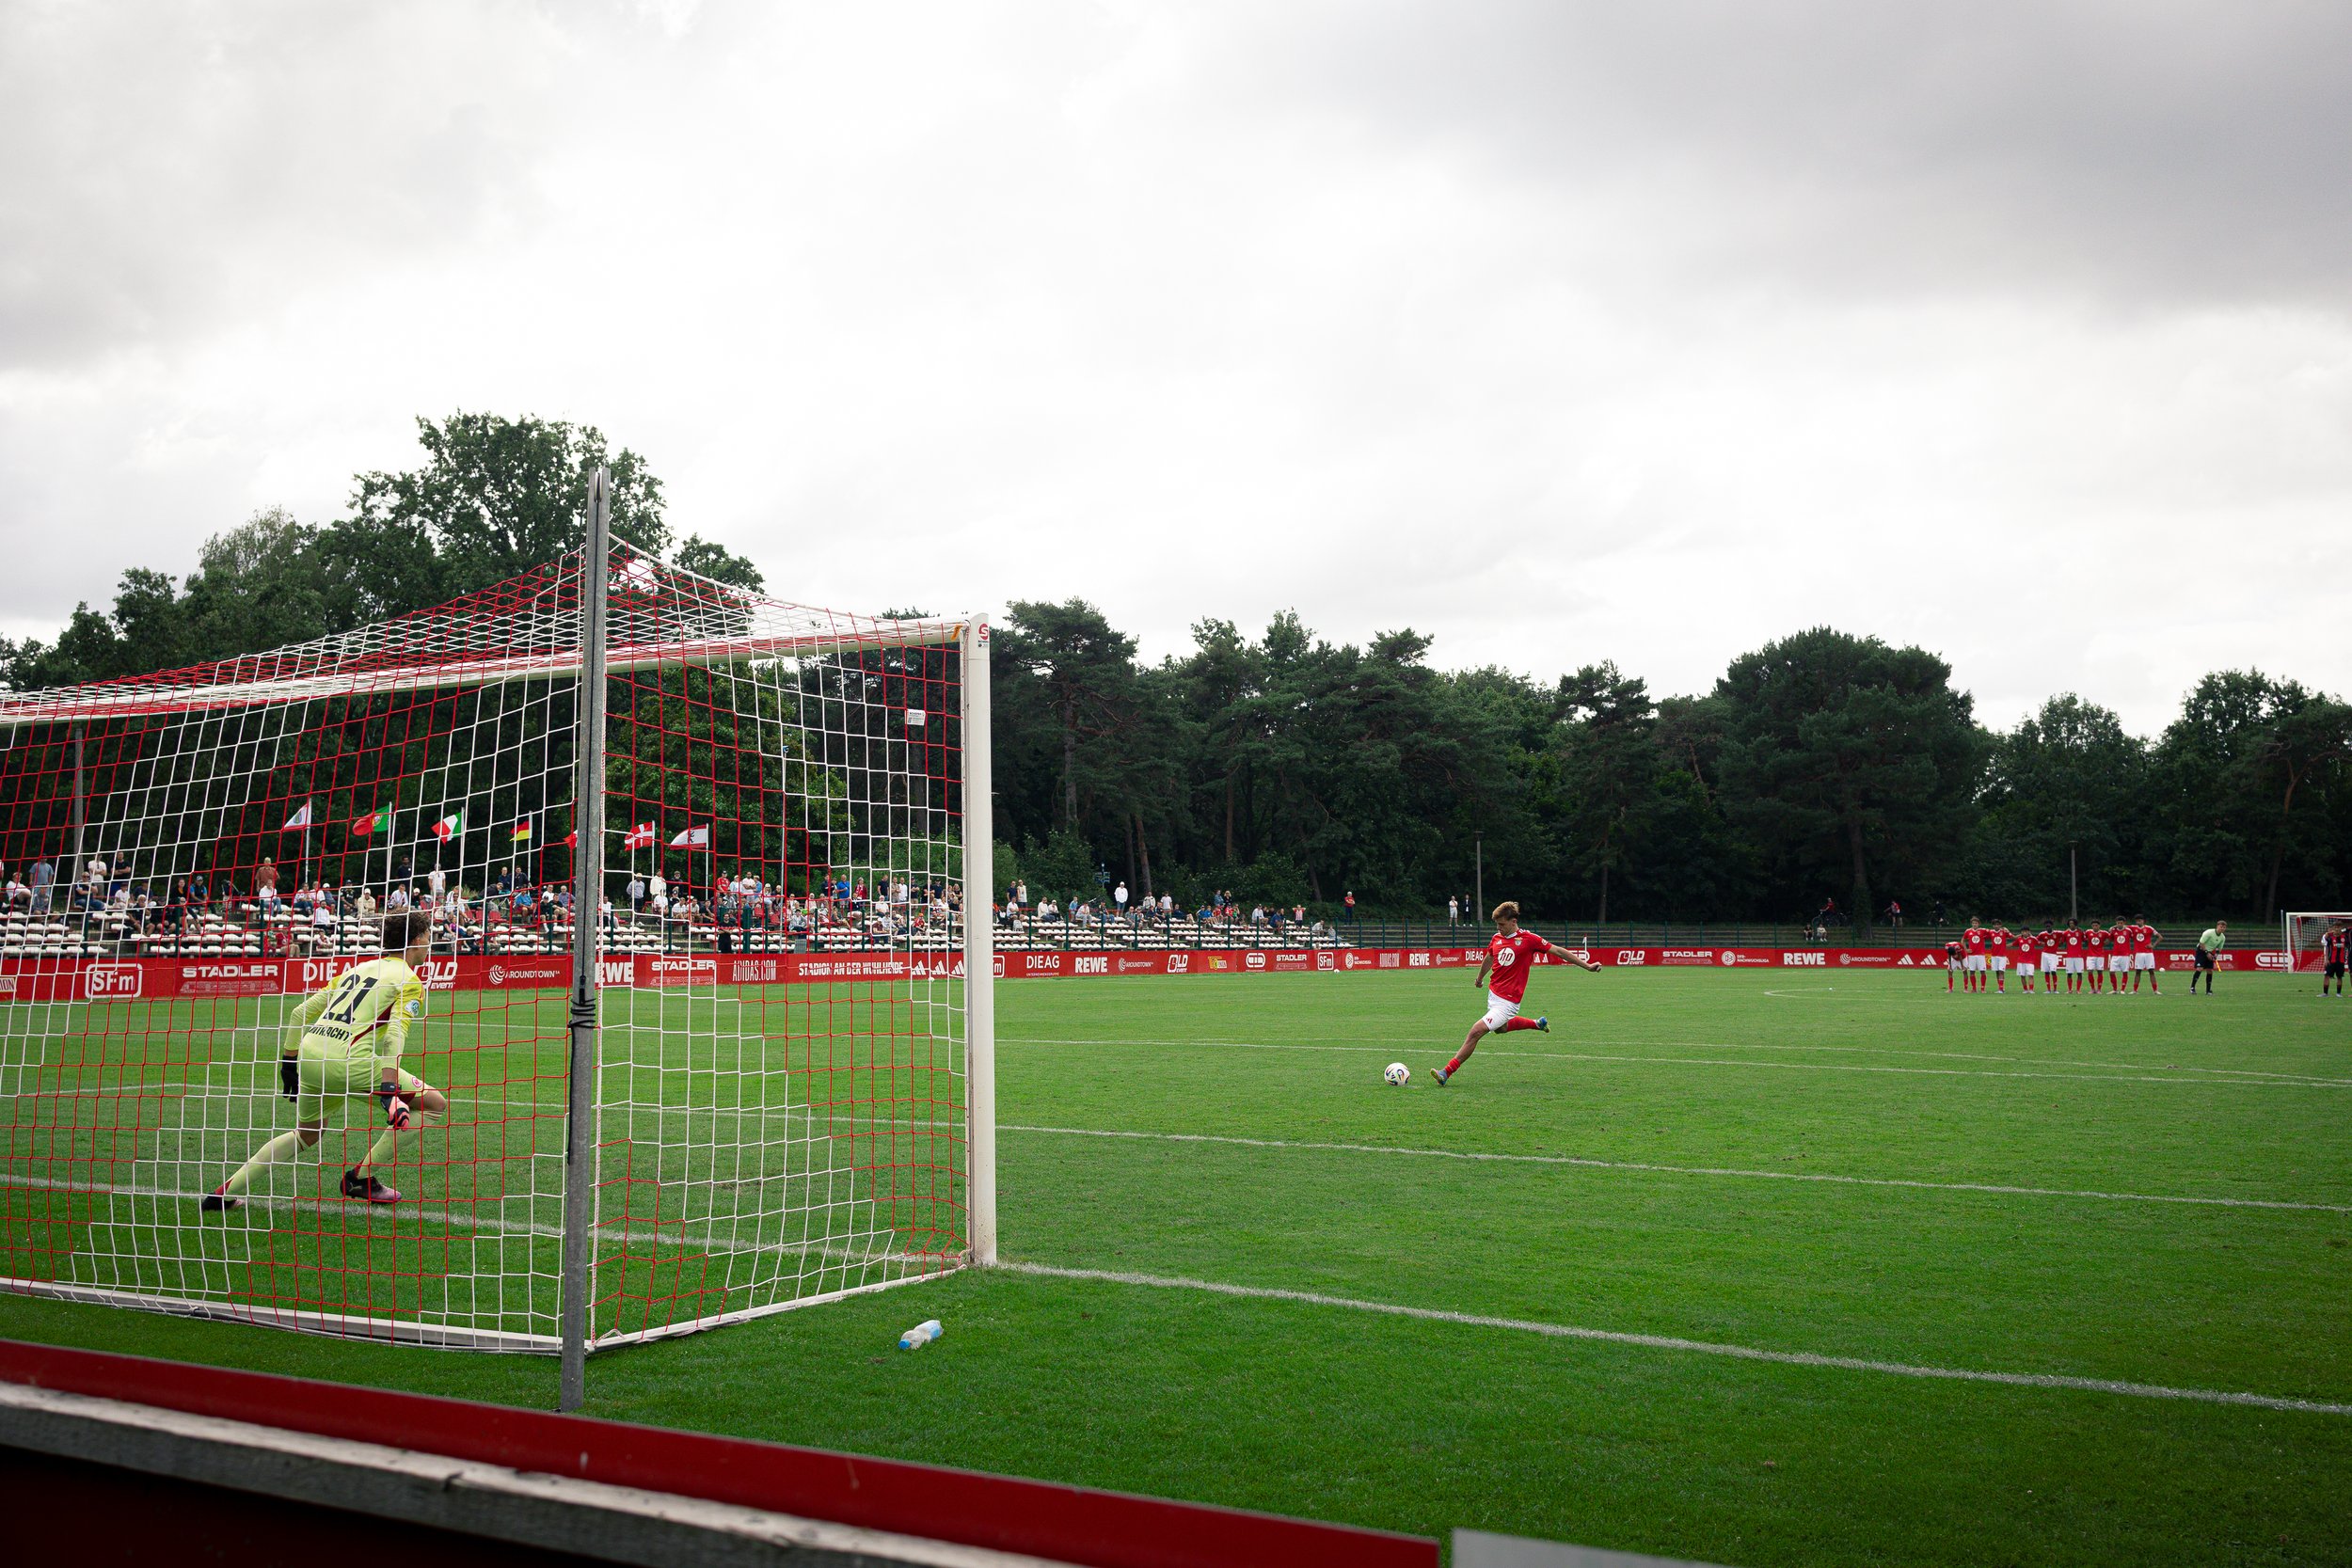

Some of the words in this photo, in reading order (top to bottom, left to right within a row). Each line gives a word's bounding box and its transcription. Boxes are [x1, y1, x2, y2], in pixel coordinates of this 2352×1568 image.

[1026, 955, 1059, 969] DIEAG
[1409, 953, 1430, 966] REWE
[1465, 951, 1484, 961] DIEAG
[1783, 952, 1825, 965] REWE
[183, 965, 278, 978] STADLER
[651, 961, 716, 971] STADLER
[799, 962, 833, 976] STADION
[834, 962, 845, 975] AN
[847, 962, 861, 975] DER
[1074, 957, 1108, 973] REWE
[504, 971, 555, 979] AROUNDTOWN
[596, 962, 634, 984] EWE
[92, 971, 135, 991] SFm
[323, 974, 377, 1025] 21
